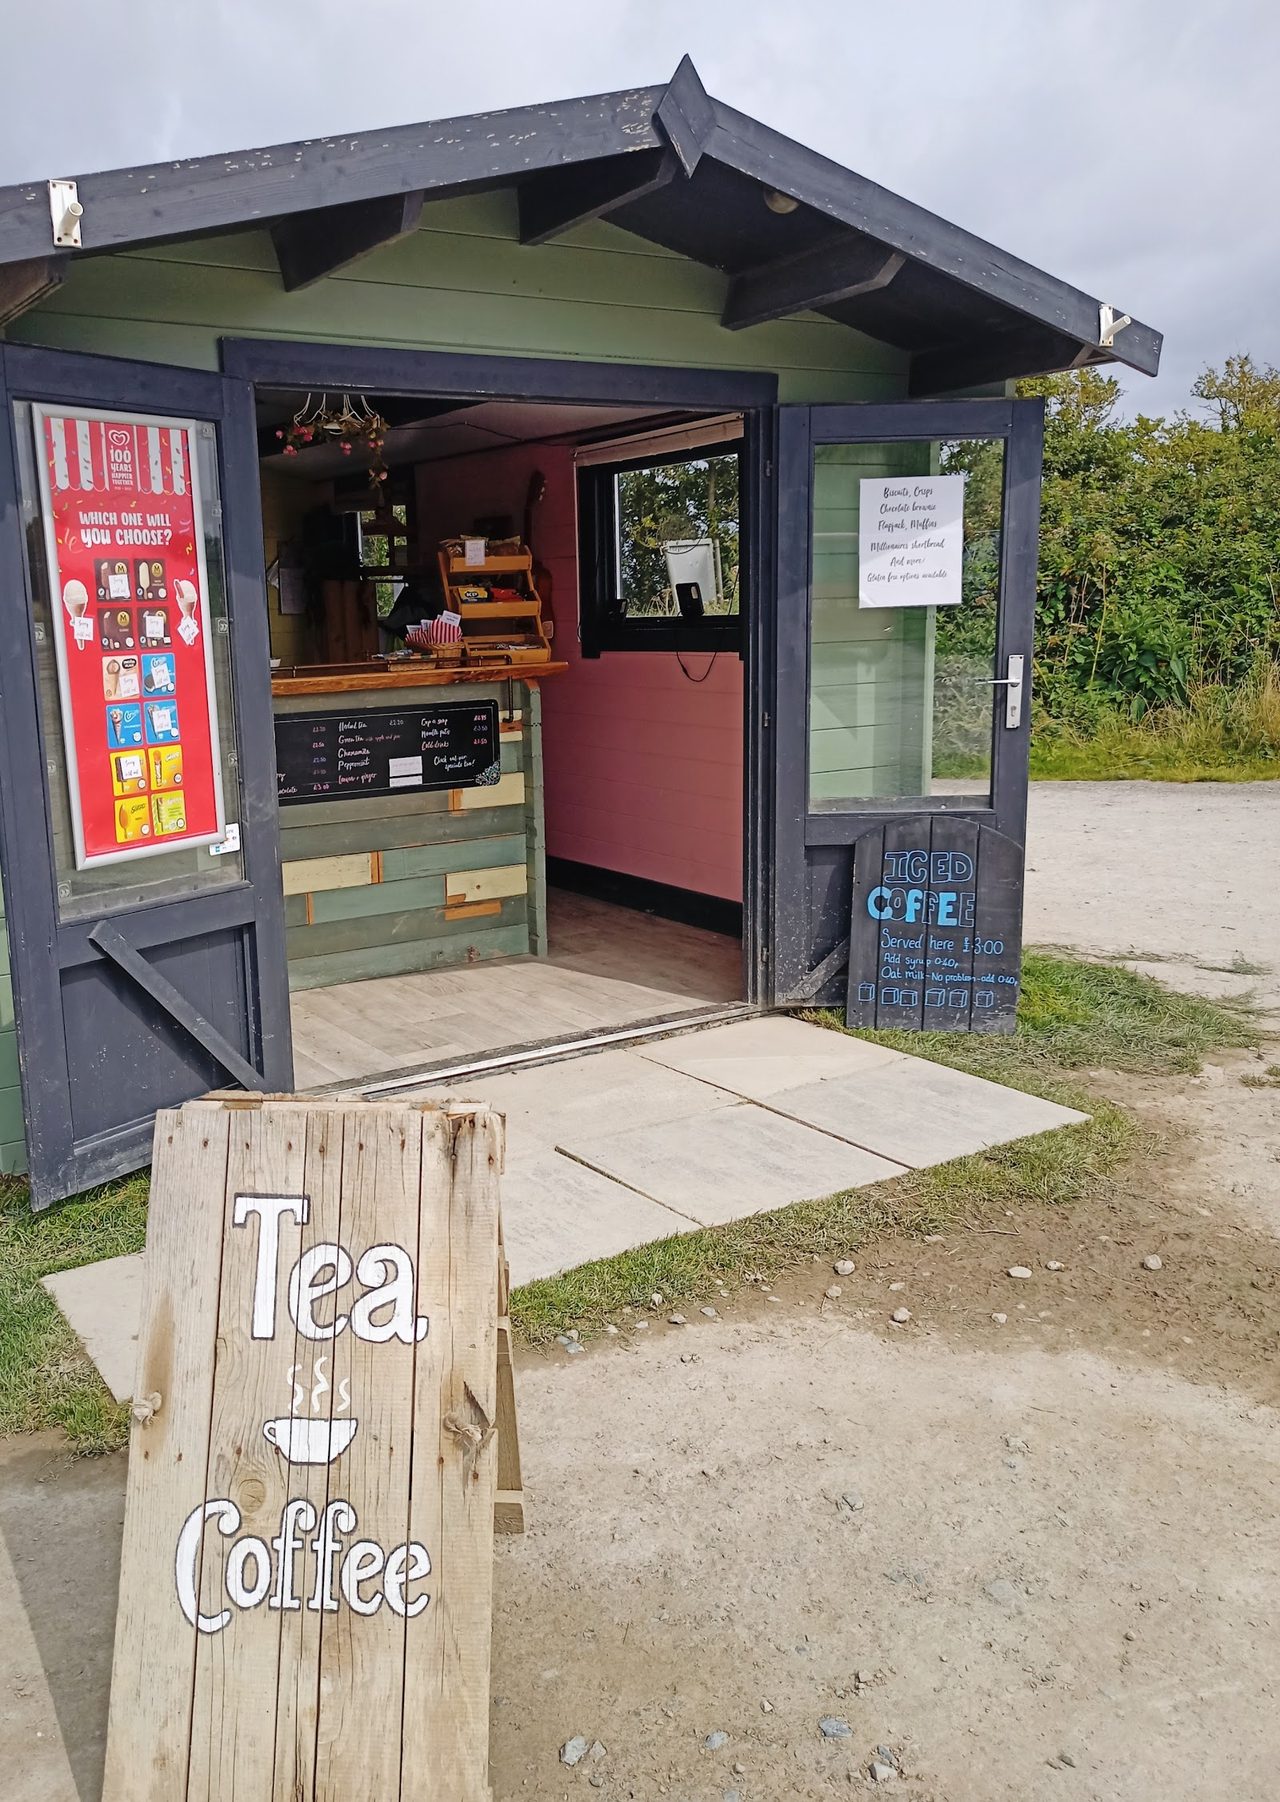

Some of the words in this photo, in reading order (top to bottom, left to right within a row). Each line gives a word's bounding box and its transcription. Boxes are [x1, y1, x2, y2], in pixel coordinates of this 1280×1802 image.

[110, 446, 131, 463] 100
[111, 463, 132, 473] YEARS
[883, 487, 912, 498] Biscuits,
[913, 486, 933, 498] Crisps
[880, 503, 910, 515] Chocolate
[912, 502, 936, 512] brownie
[79, 511, 118, 526] WHICH
[121, 512, 143, 527] ONE
[147, 513, 172, 527] WILL
[878, 519, 908, 533] Flapjack,
[910, 518, 937, 530] Muffins
[115, 529, 173, 545] CHOOSE?
[870, 542, 908, 552] Millionaires
[911, 538, 945, 549] shortbread
[890, 557, 904, 567] And
[867, 572, 886, 582] Gluten
[887, 572, 898, 582] free
[899, 572, 919, 582] options
[922, 569, 947, 579] available
[338, 735, 355, 744] Green
[434, 740, 449, 749] drinks
[884, 850, 973, 884] ICED
[867, 886, 976, 928] COFFEE
[880, 928, 923, 949] Served
[930, 935, 954, 950] here
[883, 953, 901, 964] Add
[905, 957, 931, 969] syrup
[881, 966, 902, 979] Oat
[232, 1192, 429, 1345] Tea
[174, 1498, 432, 1634] Coffee
